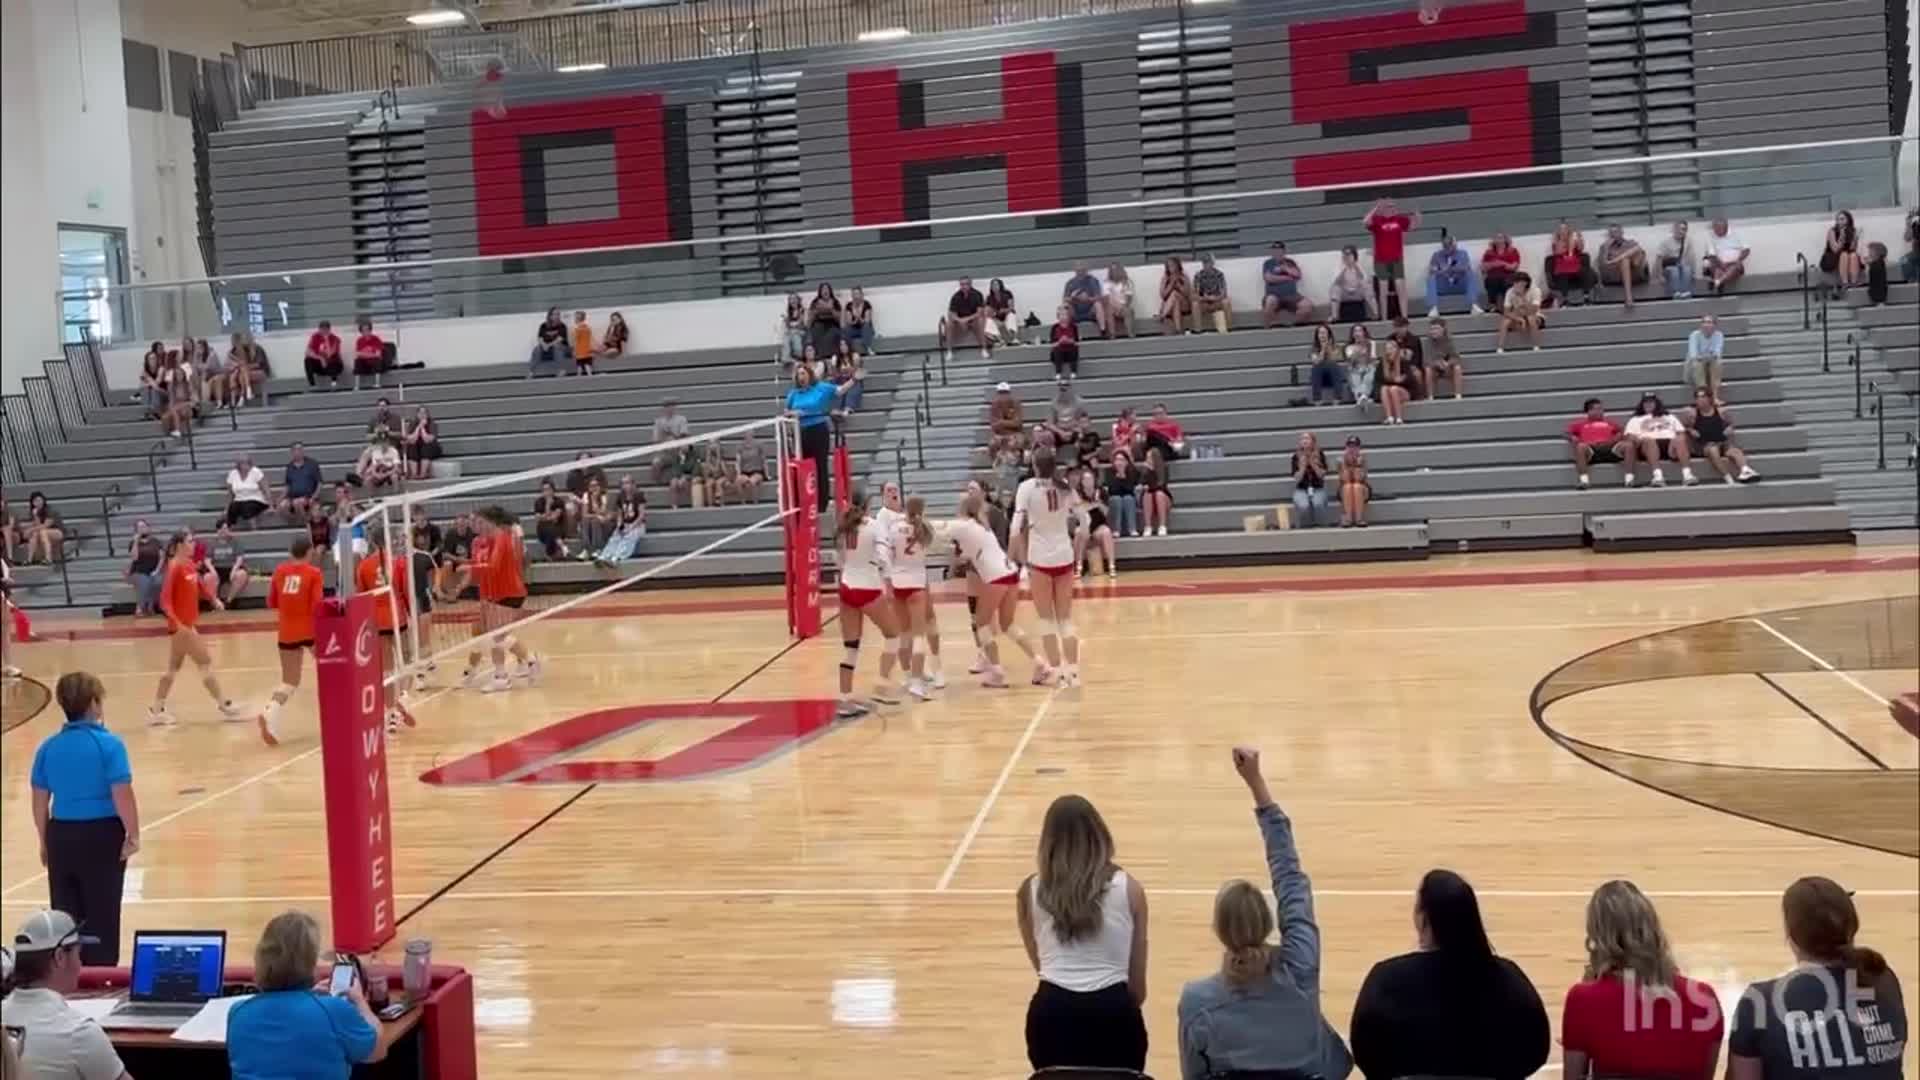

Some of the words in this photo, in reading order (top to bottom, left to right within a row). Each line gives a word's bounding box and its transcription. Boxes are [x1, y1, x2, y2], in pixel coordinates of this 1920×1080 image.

[1047, 488, 1058, 512] 11
[282, 574, 302, 594] 10
[807, 503, 820, 609] STORM
[360, 684, 387, 934] OWYHEE
[1783, 1008, 1866, 1069] ALL
